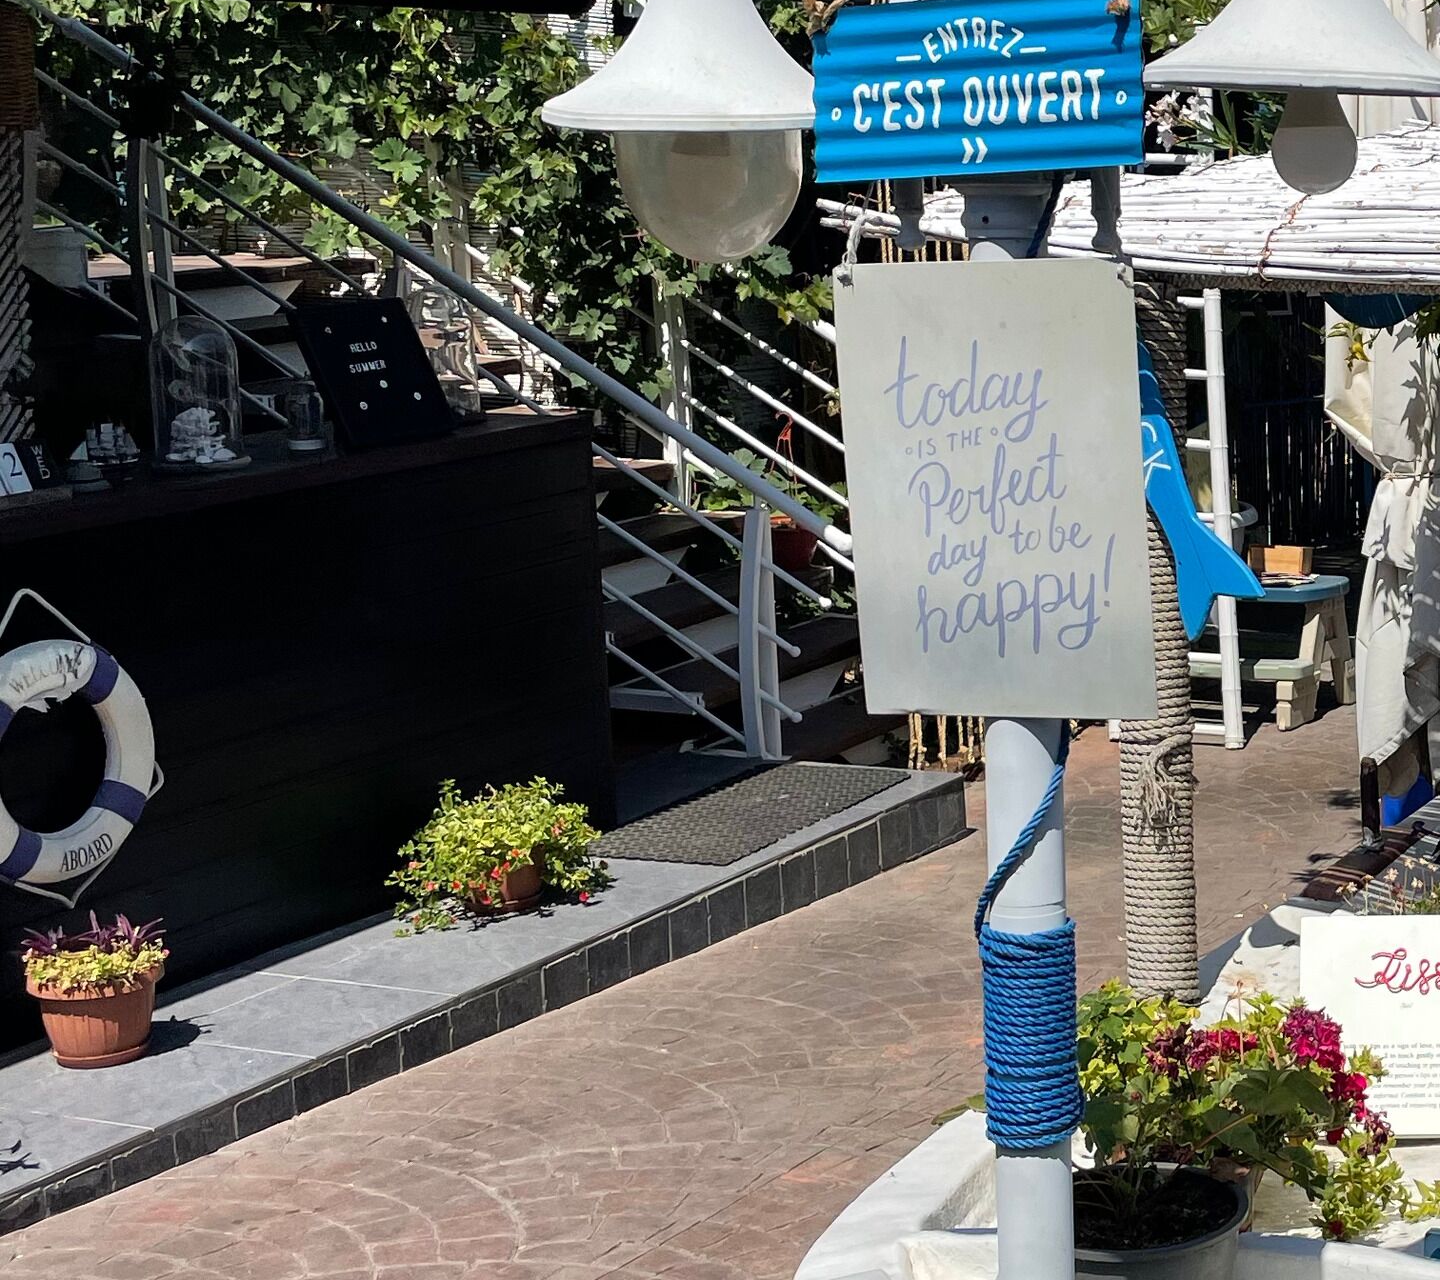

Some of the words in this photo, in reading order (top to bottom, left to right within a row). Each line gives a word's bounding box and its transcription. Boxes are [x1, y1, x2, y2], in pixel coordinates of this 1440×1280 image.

[922, 17, 1024, 63] ENTREZ
[852, 78, 945, 133] C'EST
[962, 68, 1105, 127] OUVERT
[349, 340, 378, 353] HELLO
[349, 359, 387, 374] SUMMER
[883, 335, 1048, 443] today
[30, 444, 51, 480] WED
[916, 435, 938, 459] IS
[946, 427, 983, 452] THE
[908, 432, 1067, 538] Perfect
[927, 532, 987, 587] day
[1008, 516, 1042, 555] to
[1048, 505, 1093, 553] be
[915, 533, 1117, 658] happy!
[59, 832, 113, 873] ABOARD
